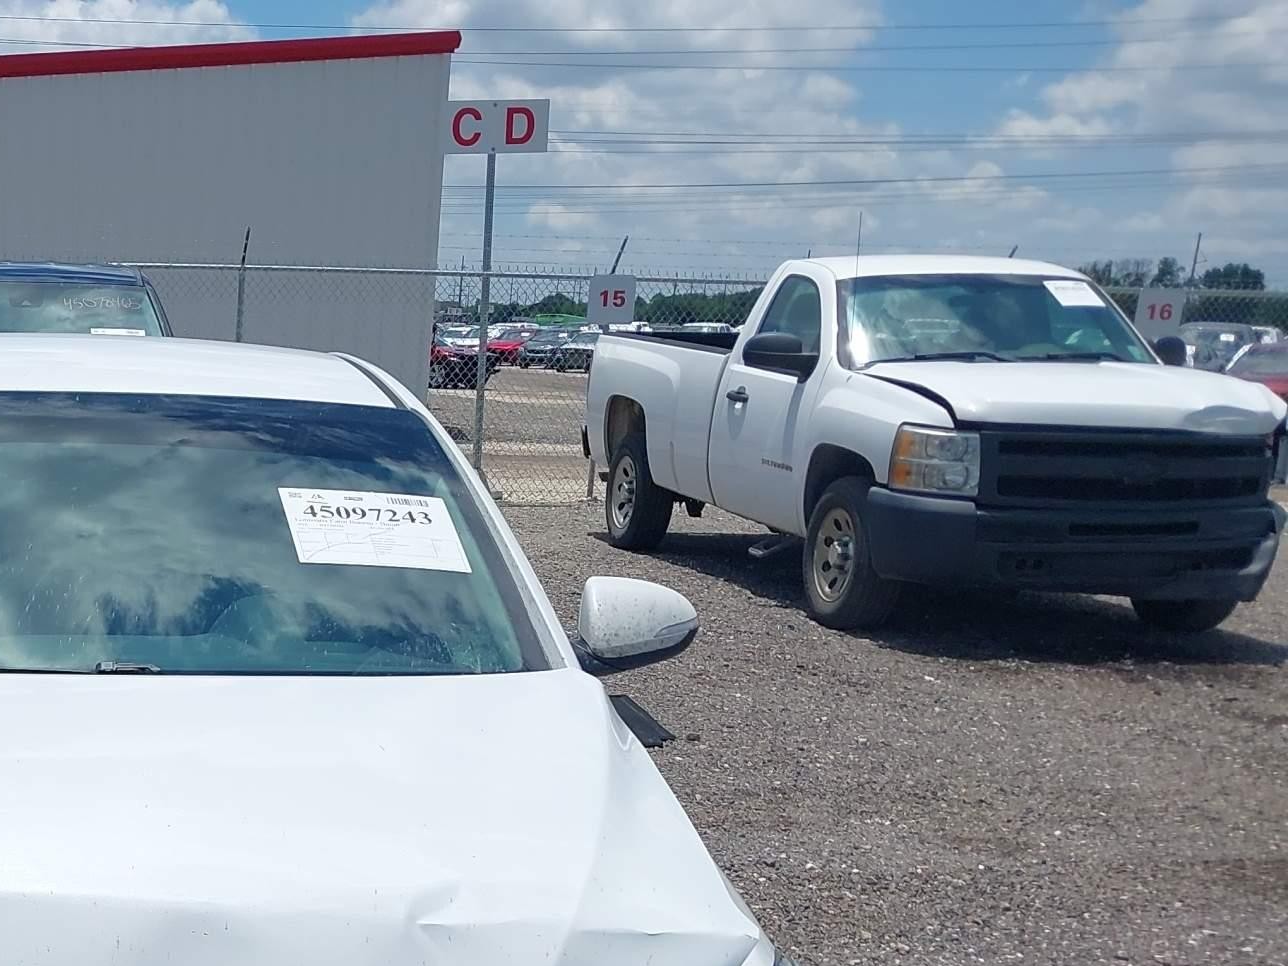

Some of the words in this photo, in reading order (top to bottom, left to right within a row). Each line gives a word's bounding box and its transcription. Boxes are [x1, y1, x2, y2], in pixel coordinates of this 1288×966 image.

[453, 109, 480, 146] C
[506, 107, 535, 145] D
[599, 289, 626, 308] 15
[1146, 303, 1173, 321] 16
[303, 504, 433, 525] 45097243
